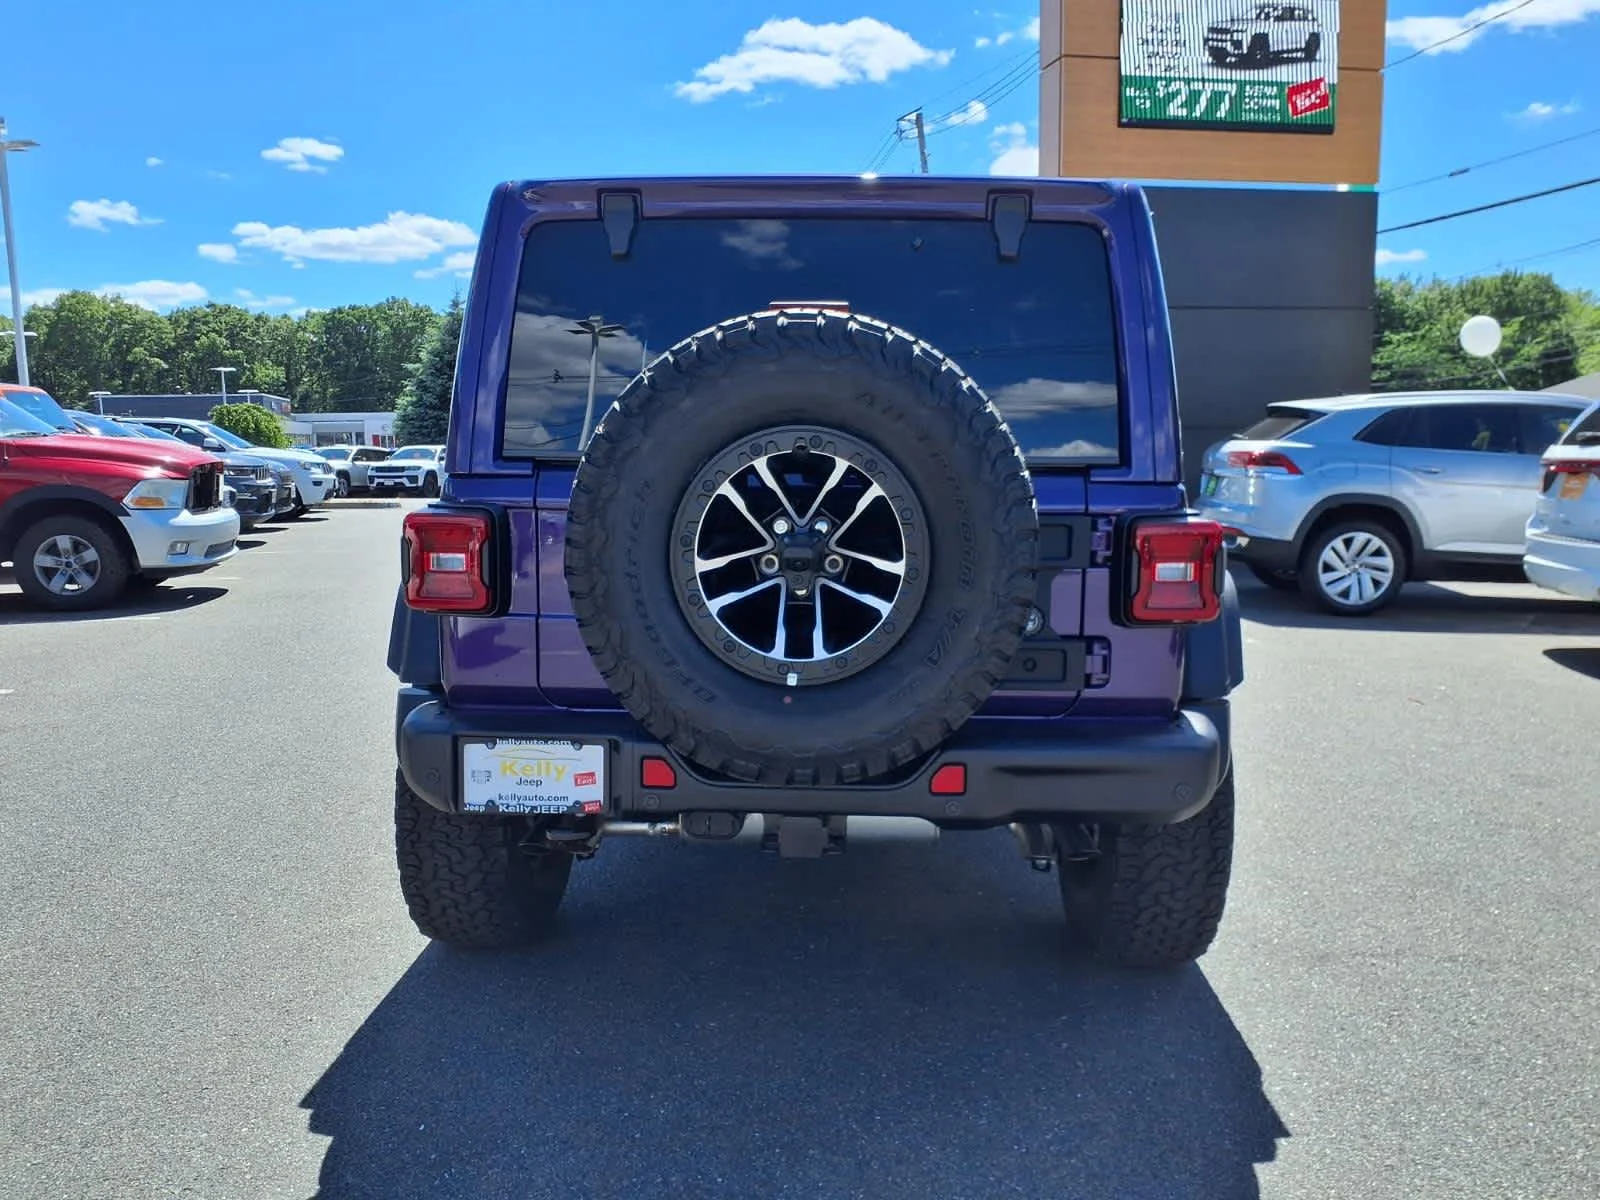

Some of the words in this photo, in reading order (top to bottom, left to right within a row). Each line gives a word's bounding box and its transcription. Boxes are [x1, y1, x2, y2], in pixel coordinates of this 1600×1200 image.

[1156, 80, 1237, 118] $277
[496, 738, 571, 748] kellyauto.com
[501, 759, 568, 781] Kelly
[515, 777, 543, 788] Jeep
[498, 792, 569, 803] kellyauto.com
[464, 803, 486, 813] Jeep
[498, 803, 531, 815] Kelly
[533, 804, 568, 814] JEEP
